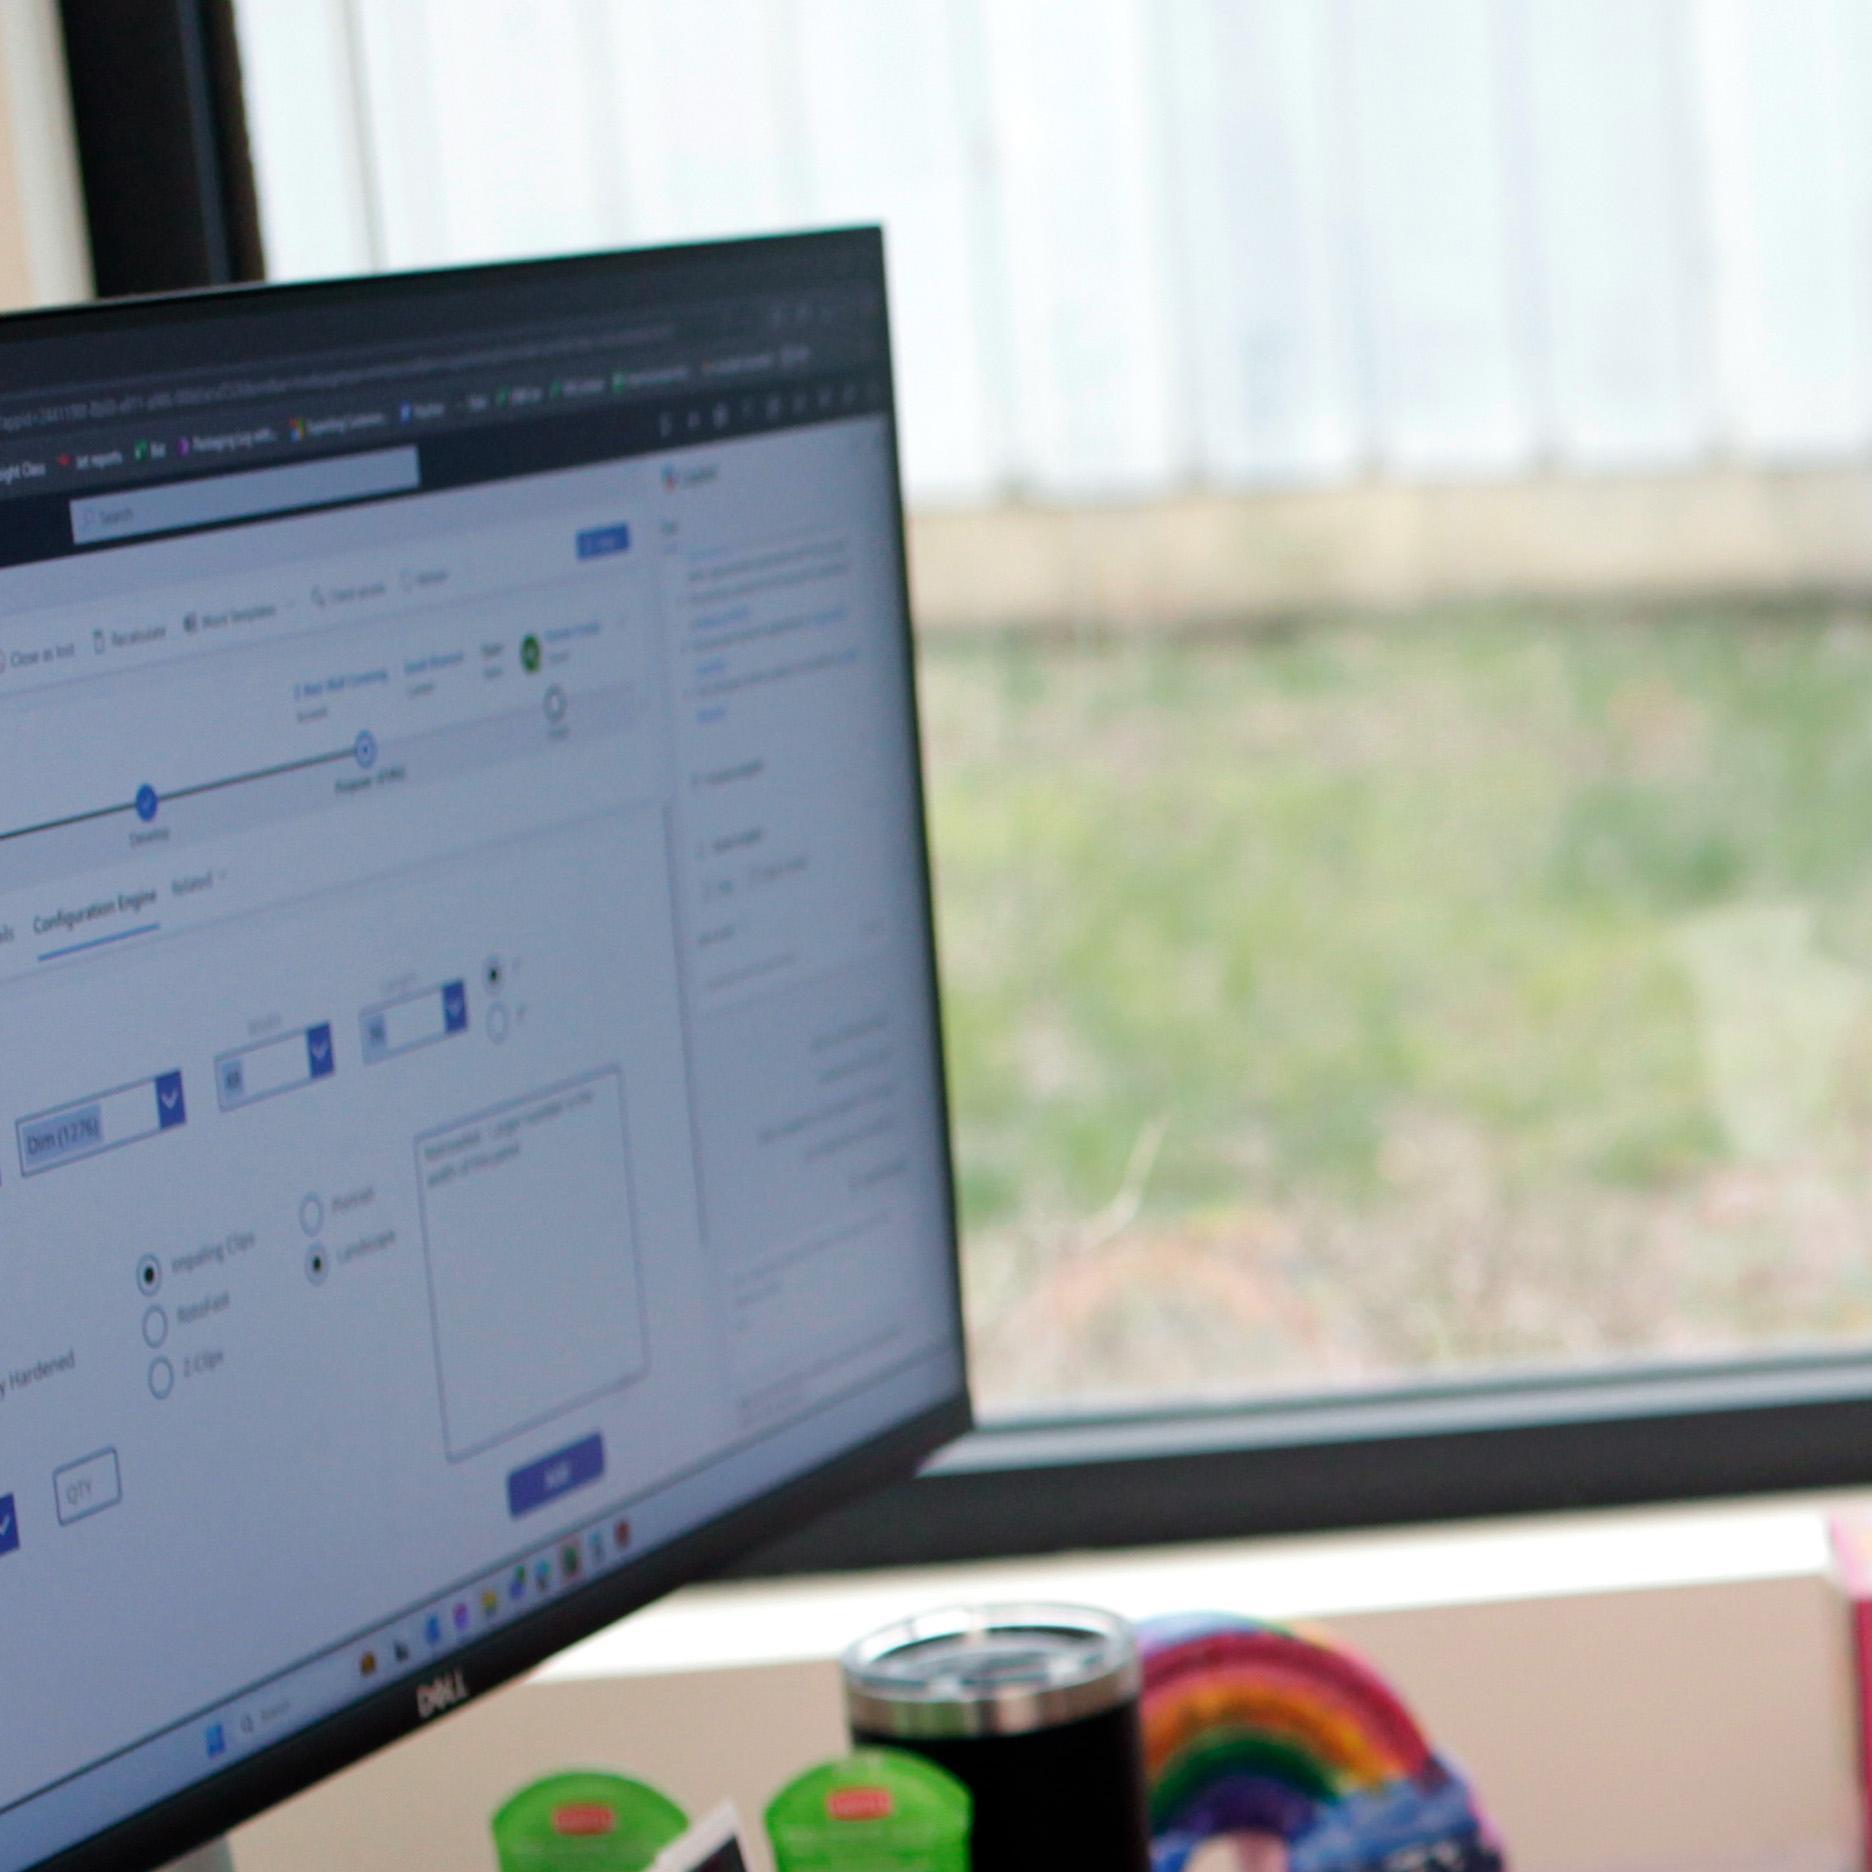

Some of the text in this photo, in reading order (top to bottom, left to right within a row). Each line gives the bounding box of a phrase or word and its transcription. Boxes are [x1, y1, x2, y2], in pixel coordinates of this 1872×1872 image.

[33, 890, 157, 935] Configuration Engine
[26, 1132, 56, 1156] Dim
[8, 1345, 76, 1392] Hardened
[415, 1666, 469, 1719] DELL
